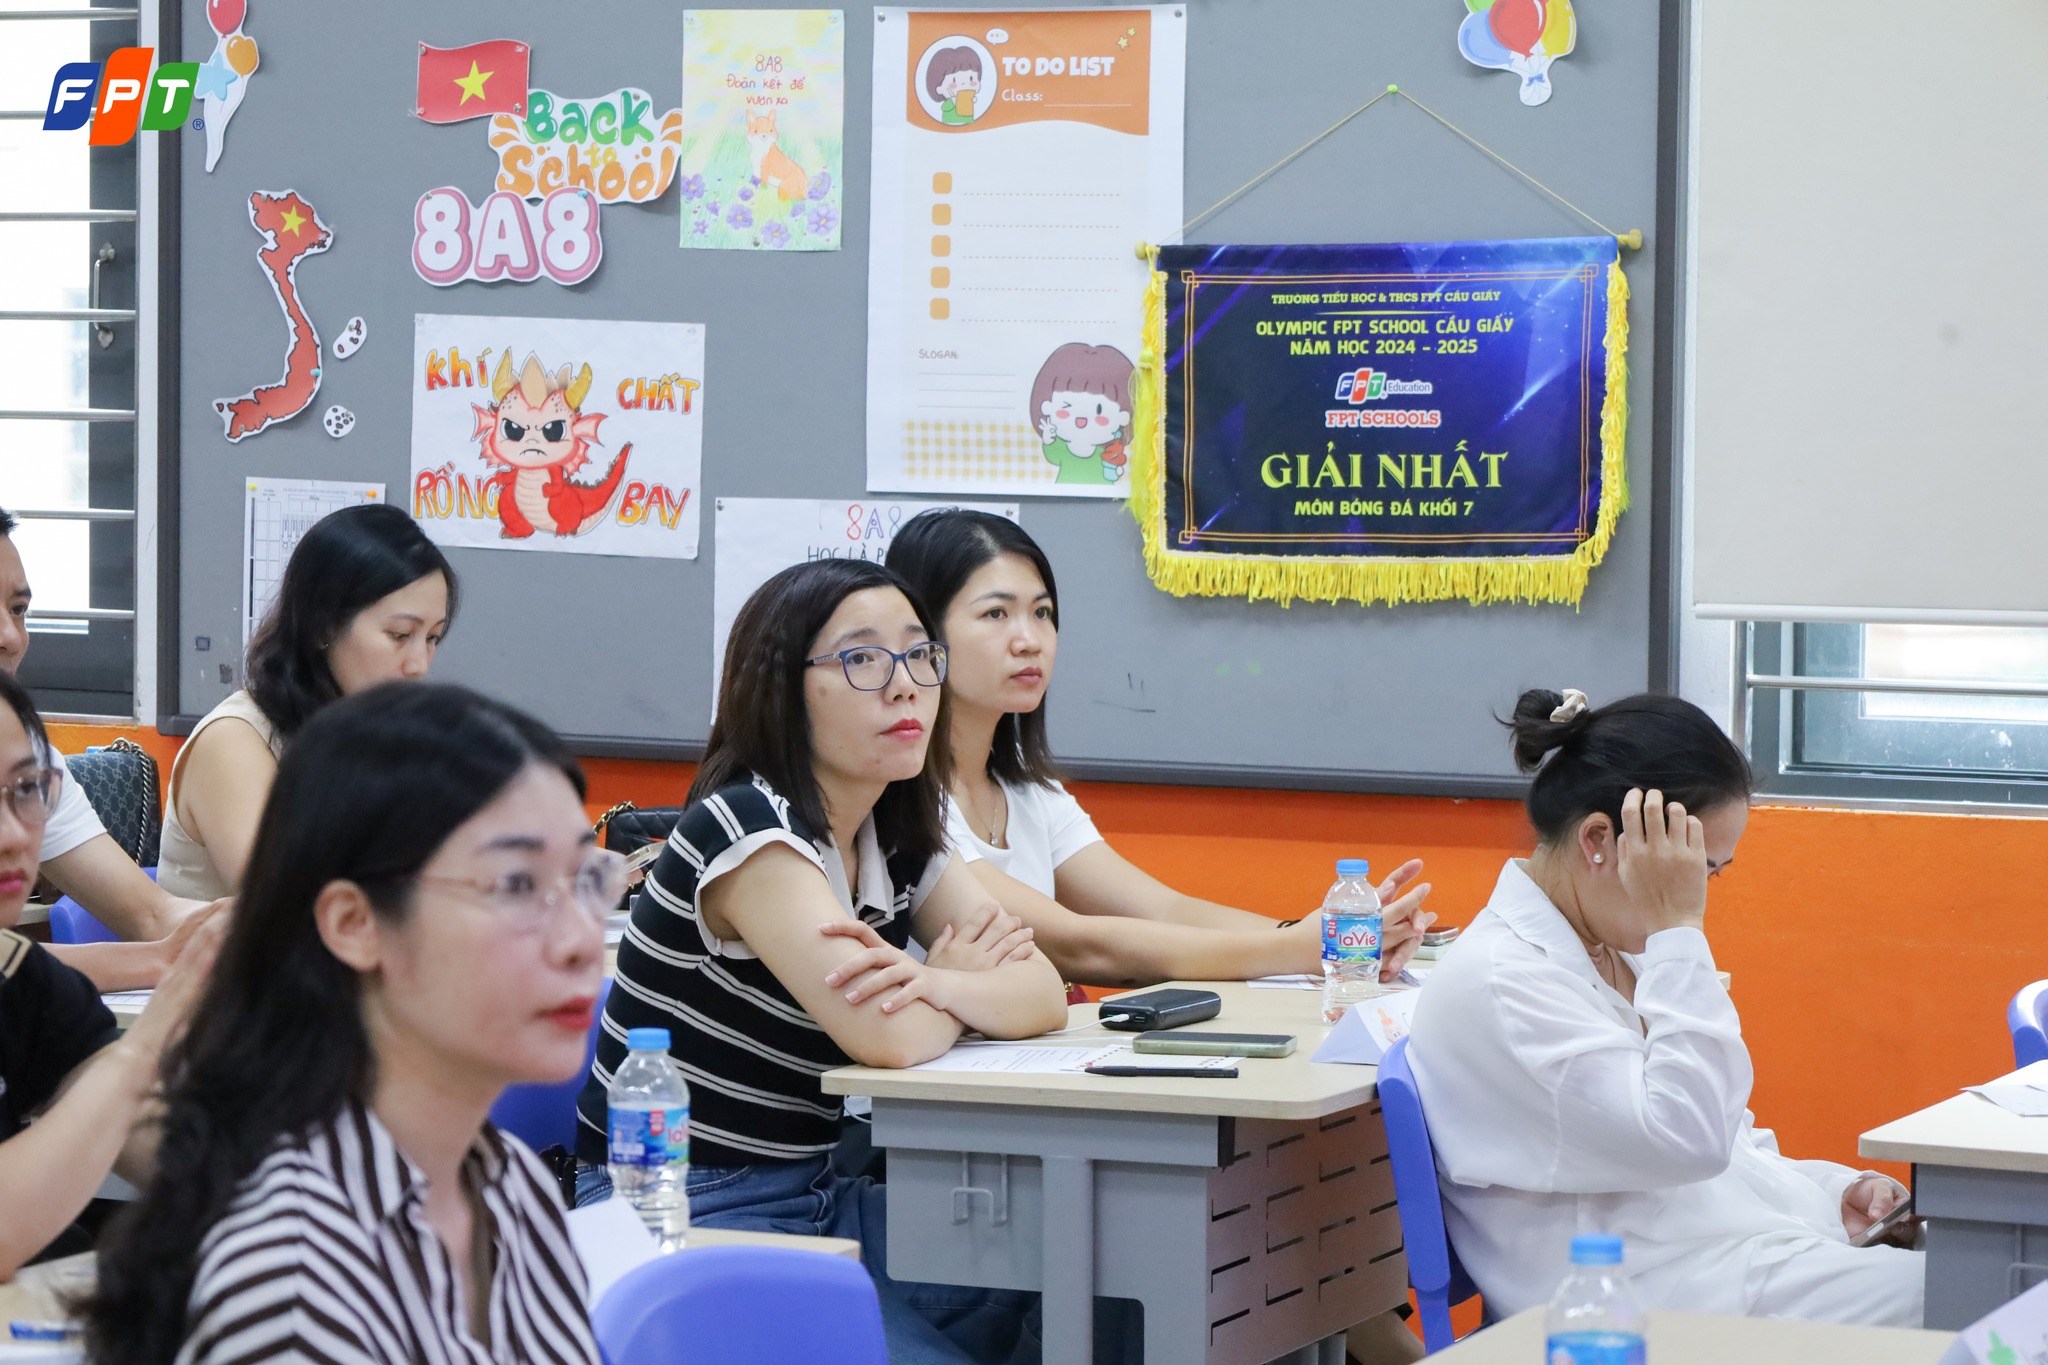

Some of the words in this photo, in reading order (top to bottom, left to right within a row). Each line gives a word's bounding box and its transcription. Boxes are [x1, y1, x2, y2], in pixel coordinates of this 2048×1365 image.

[755, 54, 783, 73] 8A8
[1002, 56, 1031, 77] TO
[1035, 56, 1065, 77] DO
[1069, 56, 1115, 76] LIST
[776, 96, 788, 106] xa
[1001, 89, 1044, 102] Class:
[522, 90, 655, 146] Back
[583, 142, 618, 168] to
[496, 143, 676, 200] School
[414, 187, 601, 284] 8A8
[1378, 292, 1387, 303] &
[1388, 292, 1418, 303] THCS
[1420, 291, 1442, 303] FPT
[1256, 320, 1327, 336] OLYMPIC
[1333, 319, 1363, 335] FPT
[1369, 319, 1429, 335] SCHOOL
[1476, 313, 1514, 333] GIẤY
[1289, 338, 1331, 355] NĂM
[1337, 339, 1370, 356] HỌC
[1375, 339, 1416, 355] 2024
[1436, 338, 1478, 354] 2025
[616, 371, 700, 414] CHẤT
[1388, 380, 1431, 393] Education
[1327, 411, 1358, 426] FPT
[1361, 411, 1439, 426] SCHOOLS
[1260, 440, 1363, 489] GIẢI
[1376, 439, 1509, 489] NHẤT
[616, 479, 691, 530] BAY
[1294, 498, 1334, 516] MÔN
[1339, 498, 1383, 516] BÓNG
[1390, 498, 1413, 516] ĐÁ
[1419, 496, 1457, 516] KHỐI
[1463, 501, 1474, 516] 7
[846, 504, 902, 541] 8A8
[1338, 931, 1377, 946] laVie
